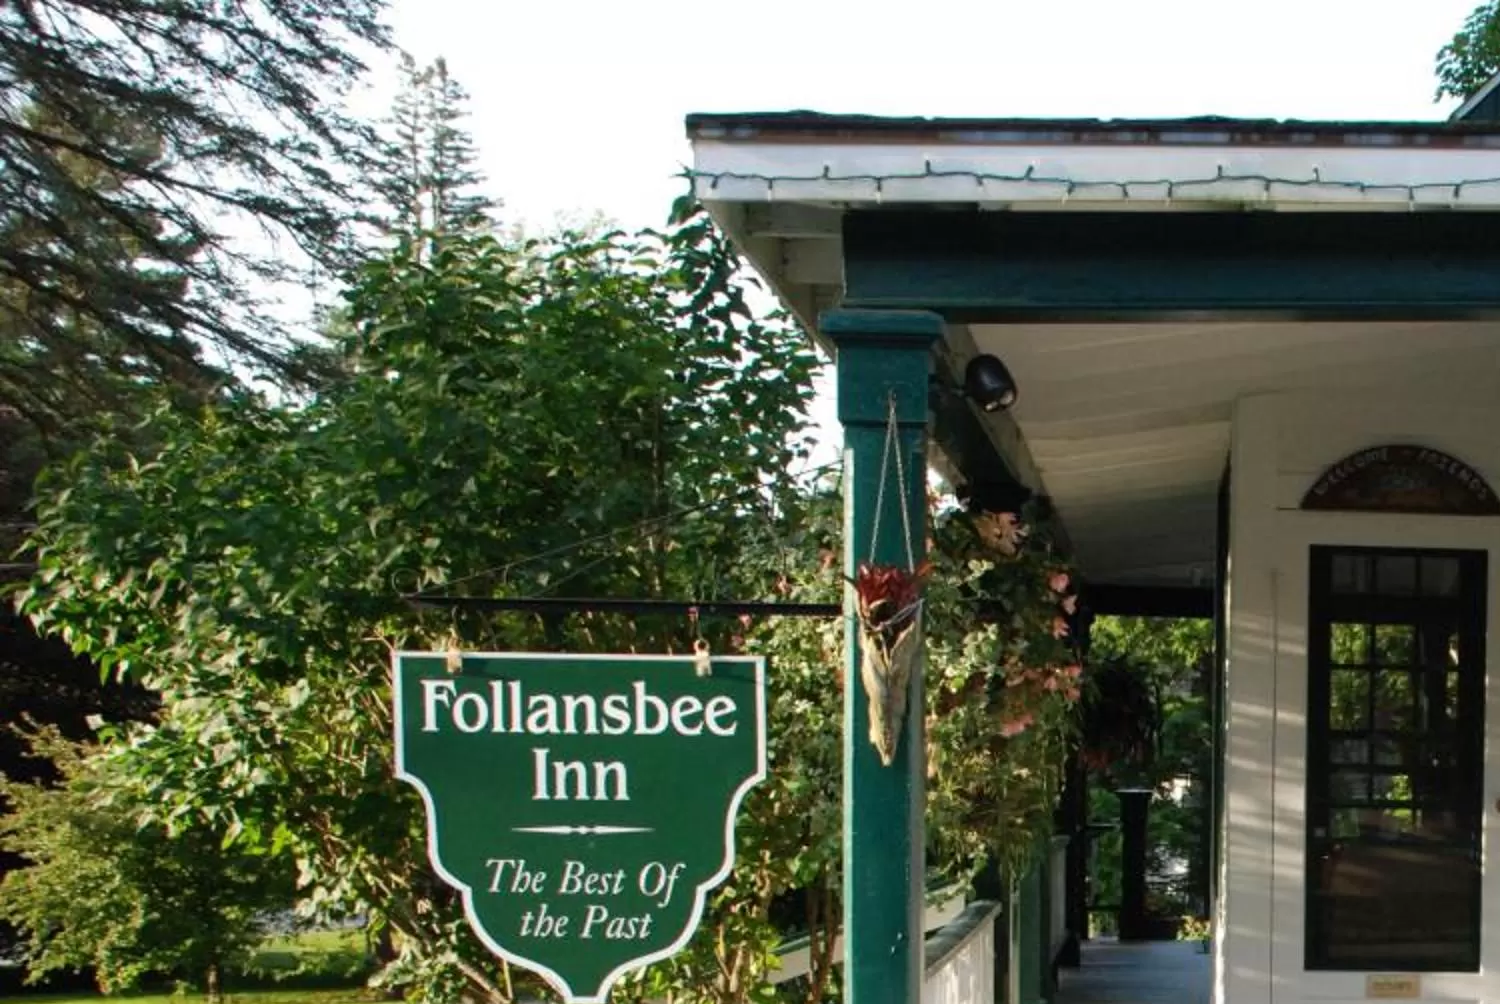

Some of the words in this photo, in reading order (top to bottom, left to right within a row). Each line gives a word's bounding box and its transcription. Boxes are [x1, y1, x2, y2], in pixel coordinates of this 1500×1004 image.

[420, 679, 738, 737] Follansbee
[531, 747, 630, 801] Inn
[485, 859, 546, 894] The
[559, 861, 625, 896] Best
[638, 861, 686, 908] Of
[519, 903, 568, 938] the
[579, 904, 652, 940] Past
